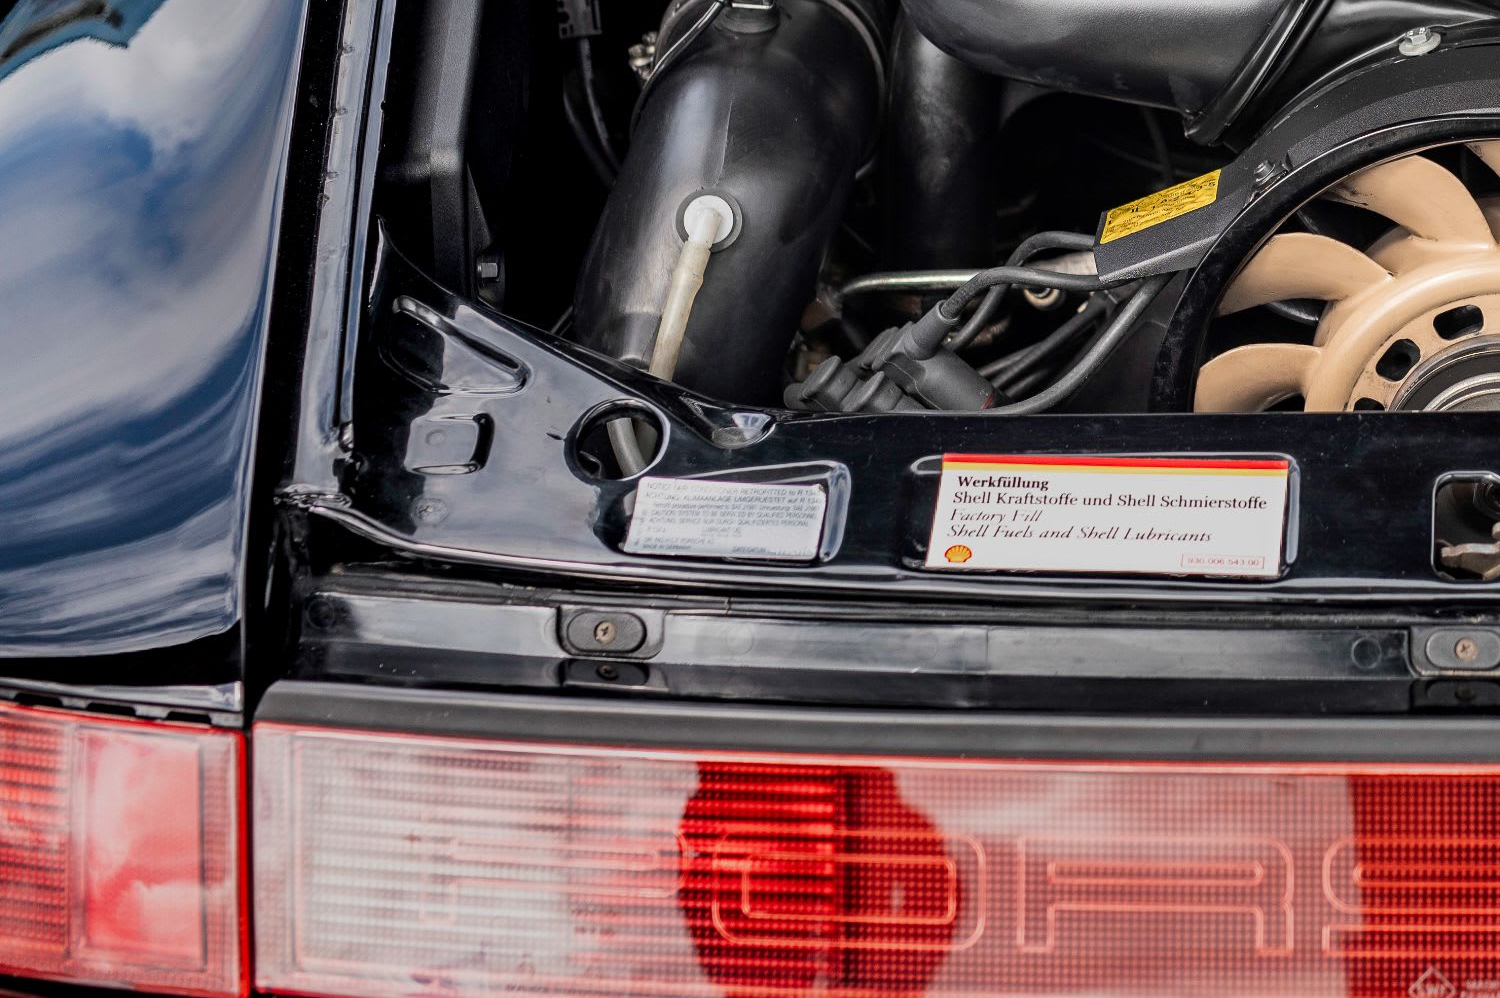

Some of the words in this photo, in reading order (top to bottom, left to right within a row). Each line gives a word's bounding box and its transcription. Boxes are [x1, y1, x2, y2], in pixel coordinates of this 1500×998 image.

[958, 476, 1049, 491] Werkfüllung
[953, 491, 991, 504] Shell
[996, 492, 1078, 506] Kraftstoffe
[1083, 494, 1113, 506] und
[1117, 494, 1156, 507] Shell
[1160, 494, 1268, 510] Schmierstoffe
[950, 508, 1006, 523] Factory
[1012, 509, 1044, 522] Fill
[947, 524, 990, 537] Shell
[992, 525, 1034, 538] Fuels
[1039, 526, 1074, 539] and
[1077, 526, 1120, 540] Shell
[1123, 527, 1213, 542] Lubricants
